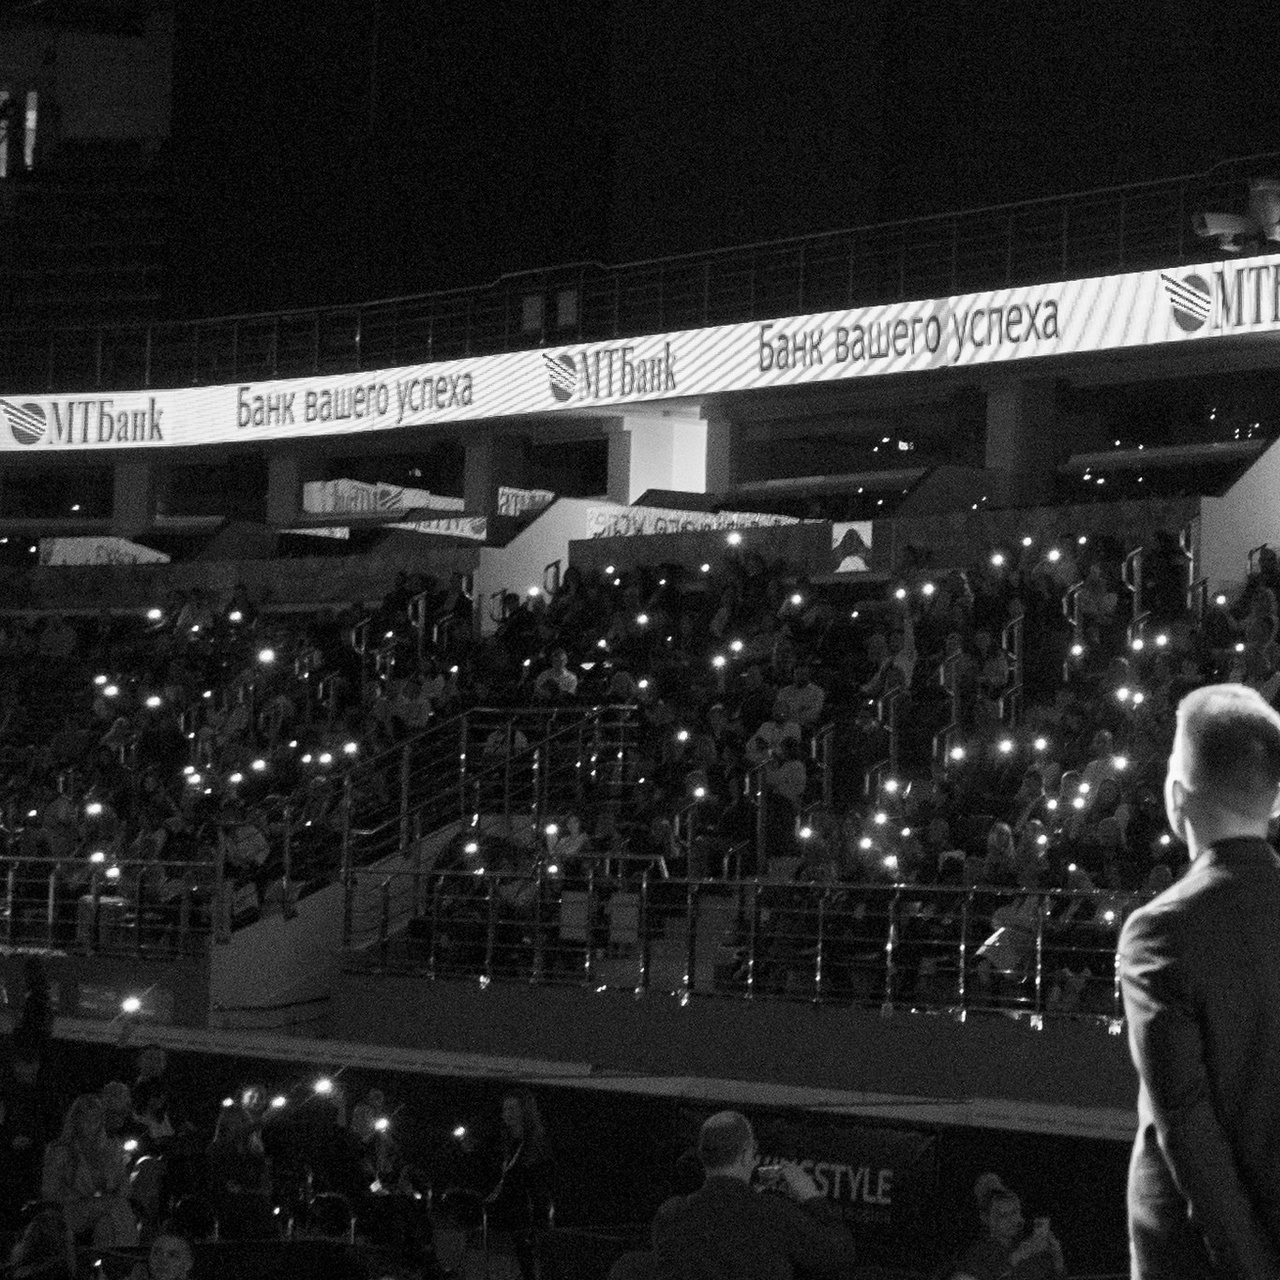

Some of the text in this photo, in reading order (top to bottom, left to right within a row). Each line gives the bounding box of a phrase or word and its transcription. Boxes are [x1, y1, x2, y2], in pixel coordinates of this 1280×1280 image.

[757, 295, 1060, 372] Банк вашего успеха
[235, 370, 475, 429] Банк вашего успеха
[577, 341, 679, 400] МТБанк
[46, 397, 165, 445] МТБанк
